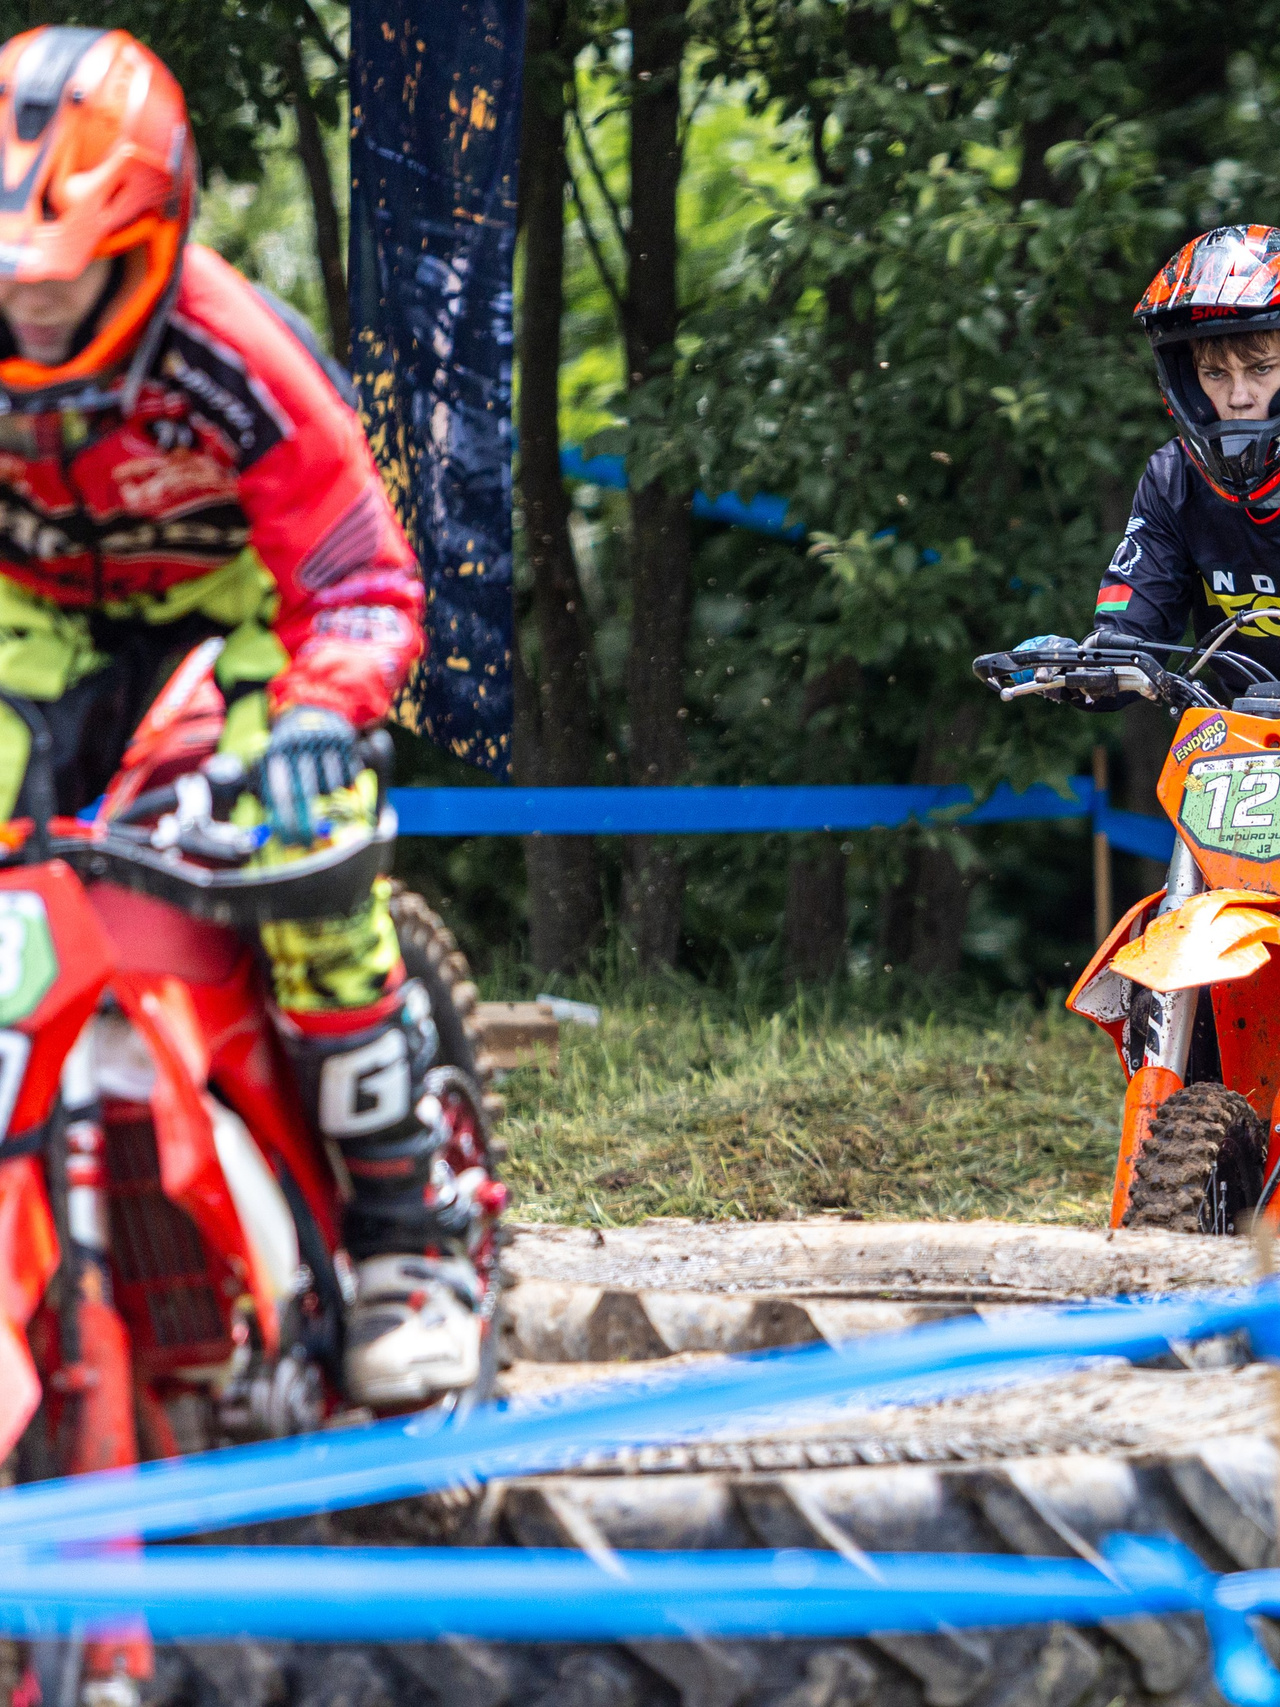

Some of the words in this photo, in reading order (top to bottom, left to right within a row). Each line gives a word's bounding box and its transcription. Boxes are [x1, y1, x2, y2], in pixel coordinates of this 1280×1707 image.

[1175, 720, 1226, 761] ENDURO
[1202, 731, 1226, 751] CUP
[1219, 832, 1267, 842] ENDURO
[1256, 844, 1271, 854] J2
